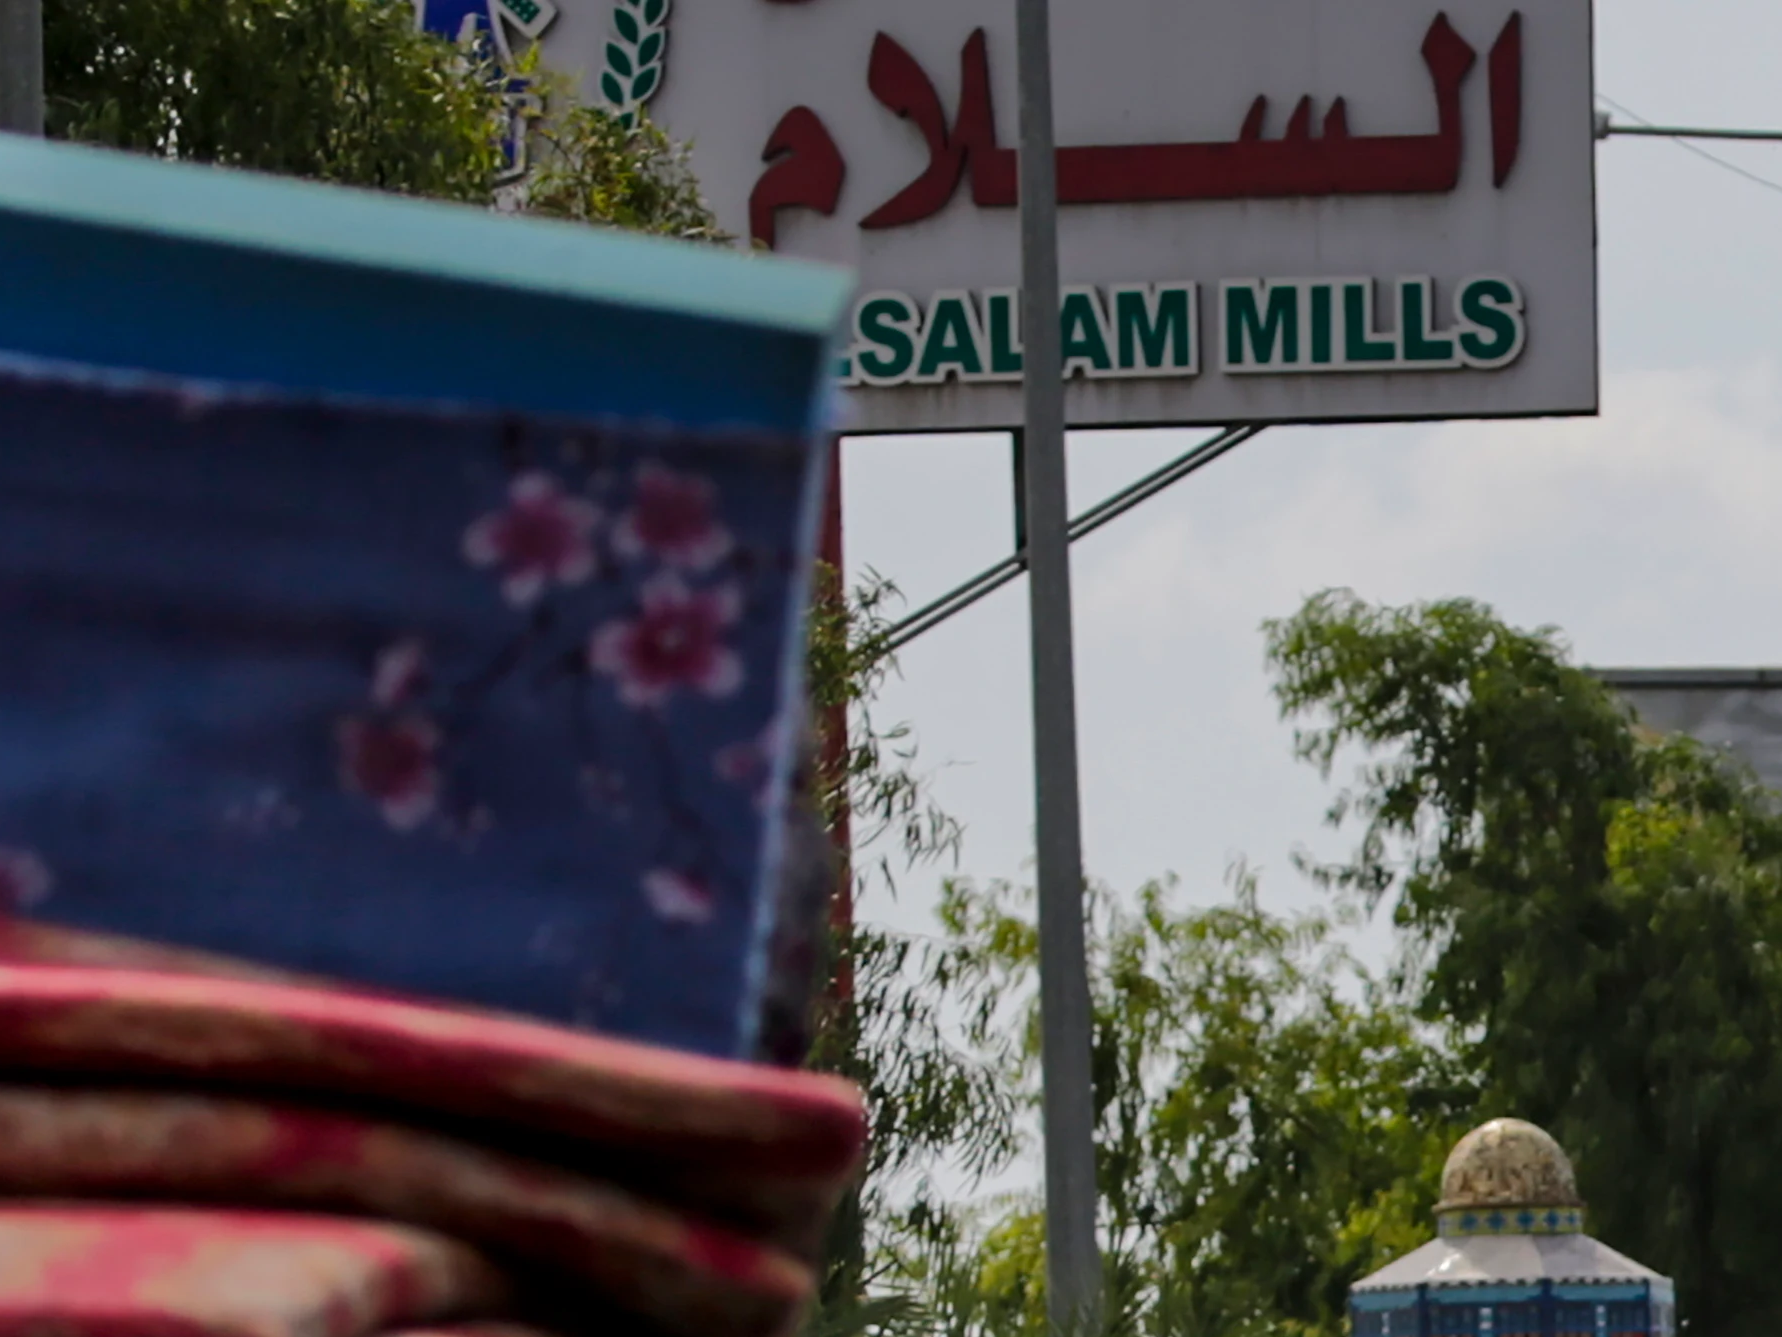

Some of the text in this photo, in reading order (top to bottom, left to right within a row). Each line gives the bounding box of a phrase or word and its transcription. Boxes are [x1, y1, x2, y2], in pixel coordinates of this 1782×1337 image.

[746, 8, 1522, 250] السلام
[838, 278, 1520, 380] SALAM MILLS
